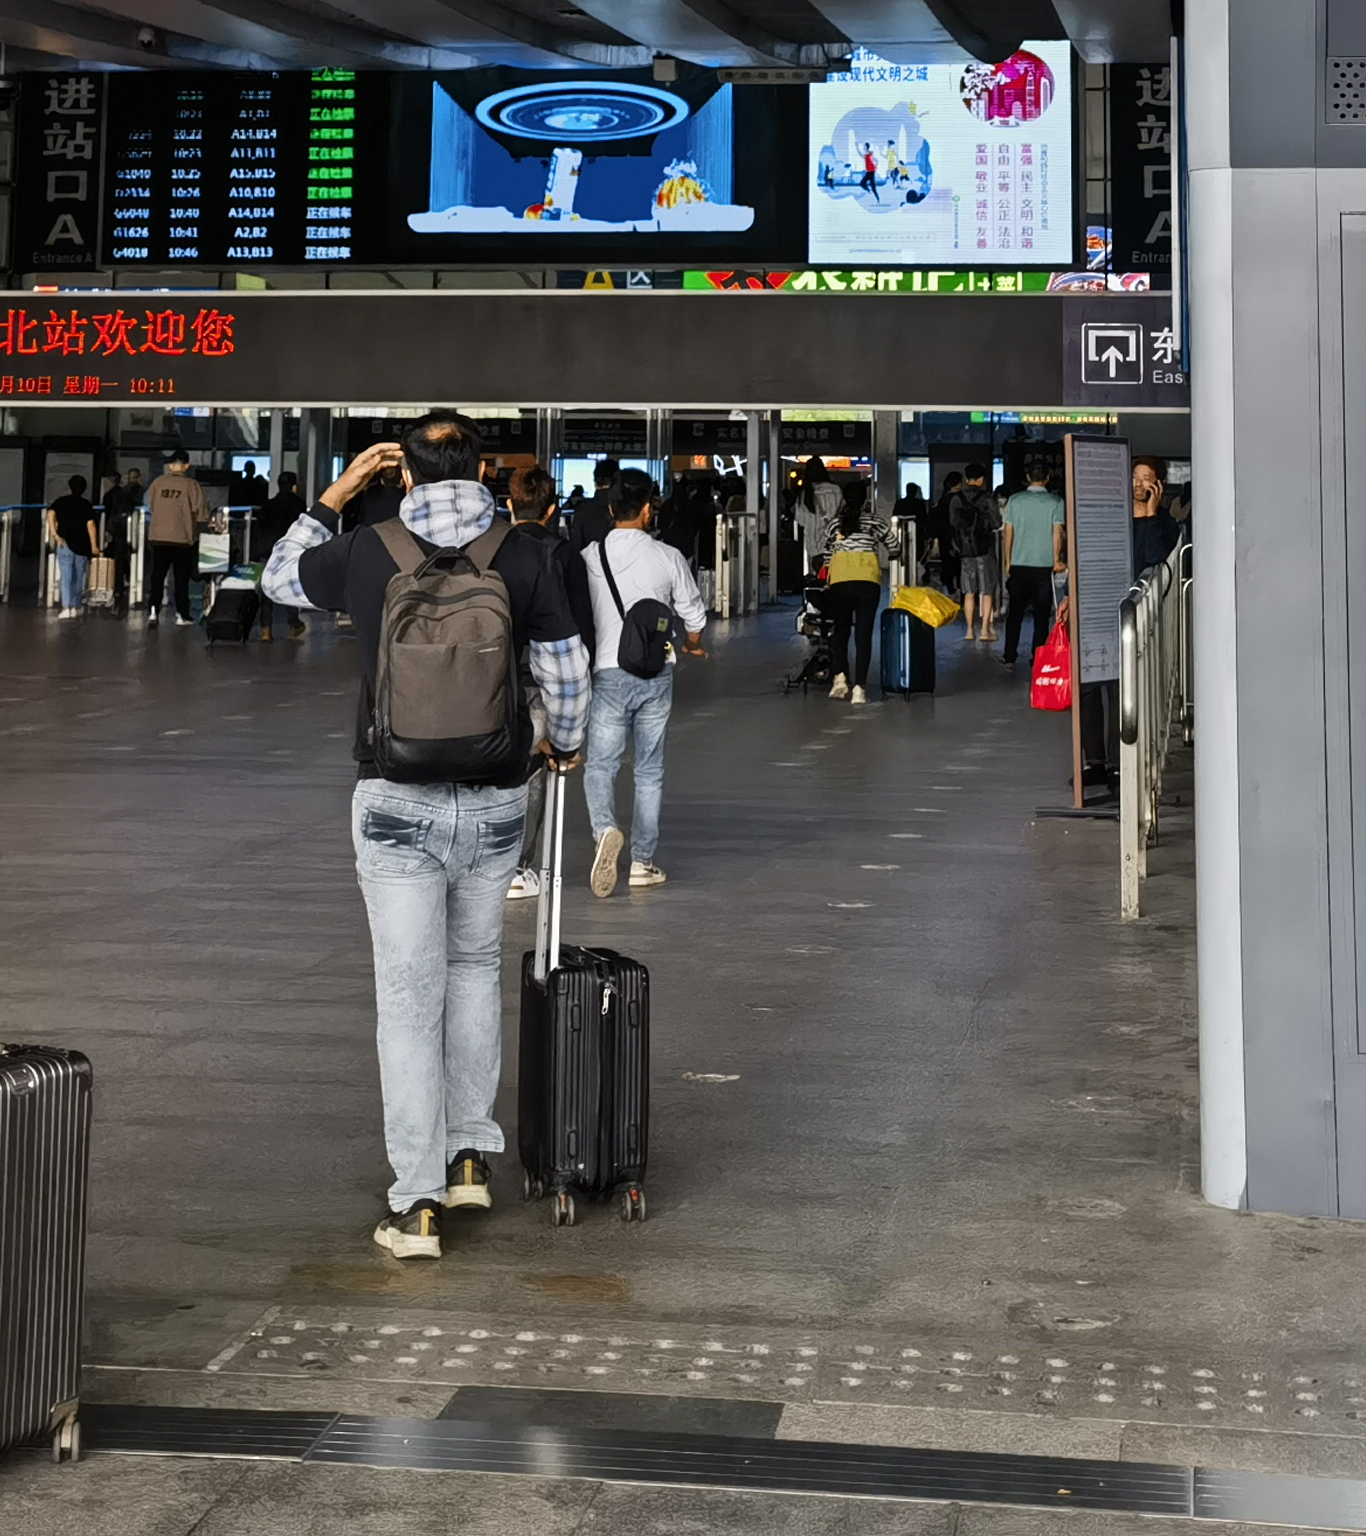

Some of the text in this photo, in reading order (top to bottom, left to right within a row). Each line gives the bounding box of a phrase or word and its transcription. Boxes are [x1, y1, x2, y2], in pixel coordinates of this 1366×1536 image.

[63, 375, 119, 395] 星期一
[130, 376, 175, 395] 10:11
